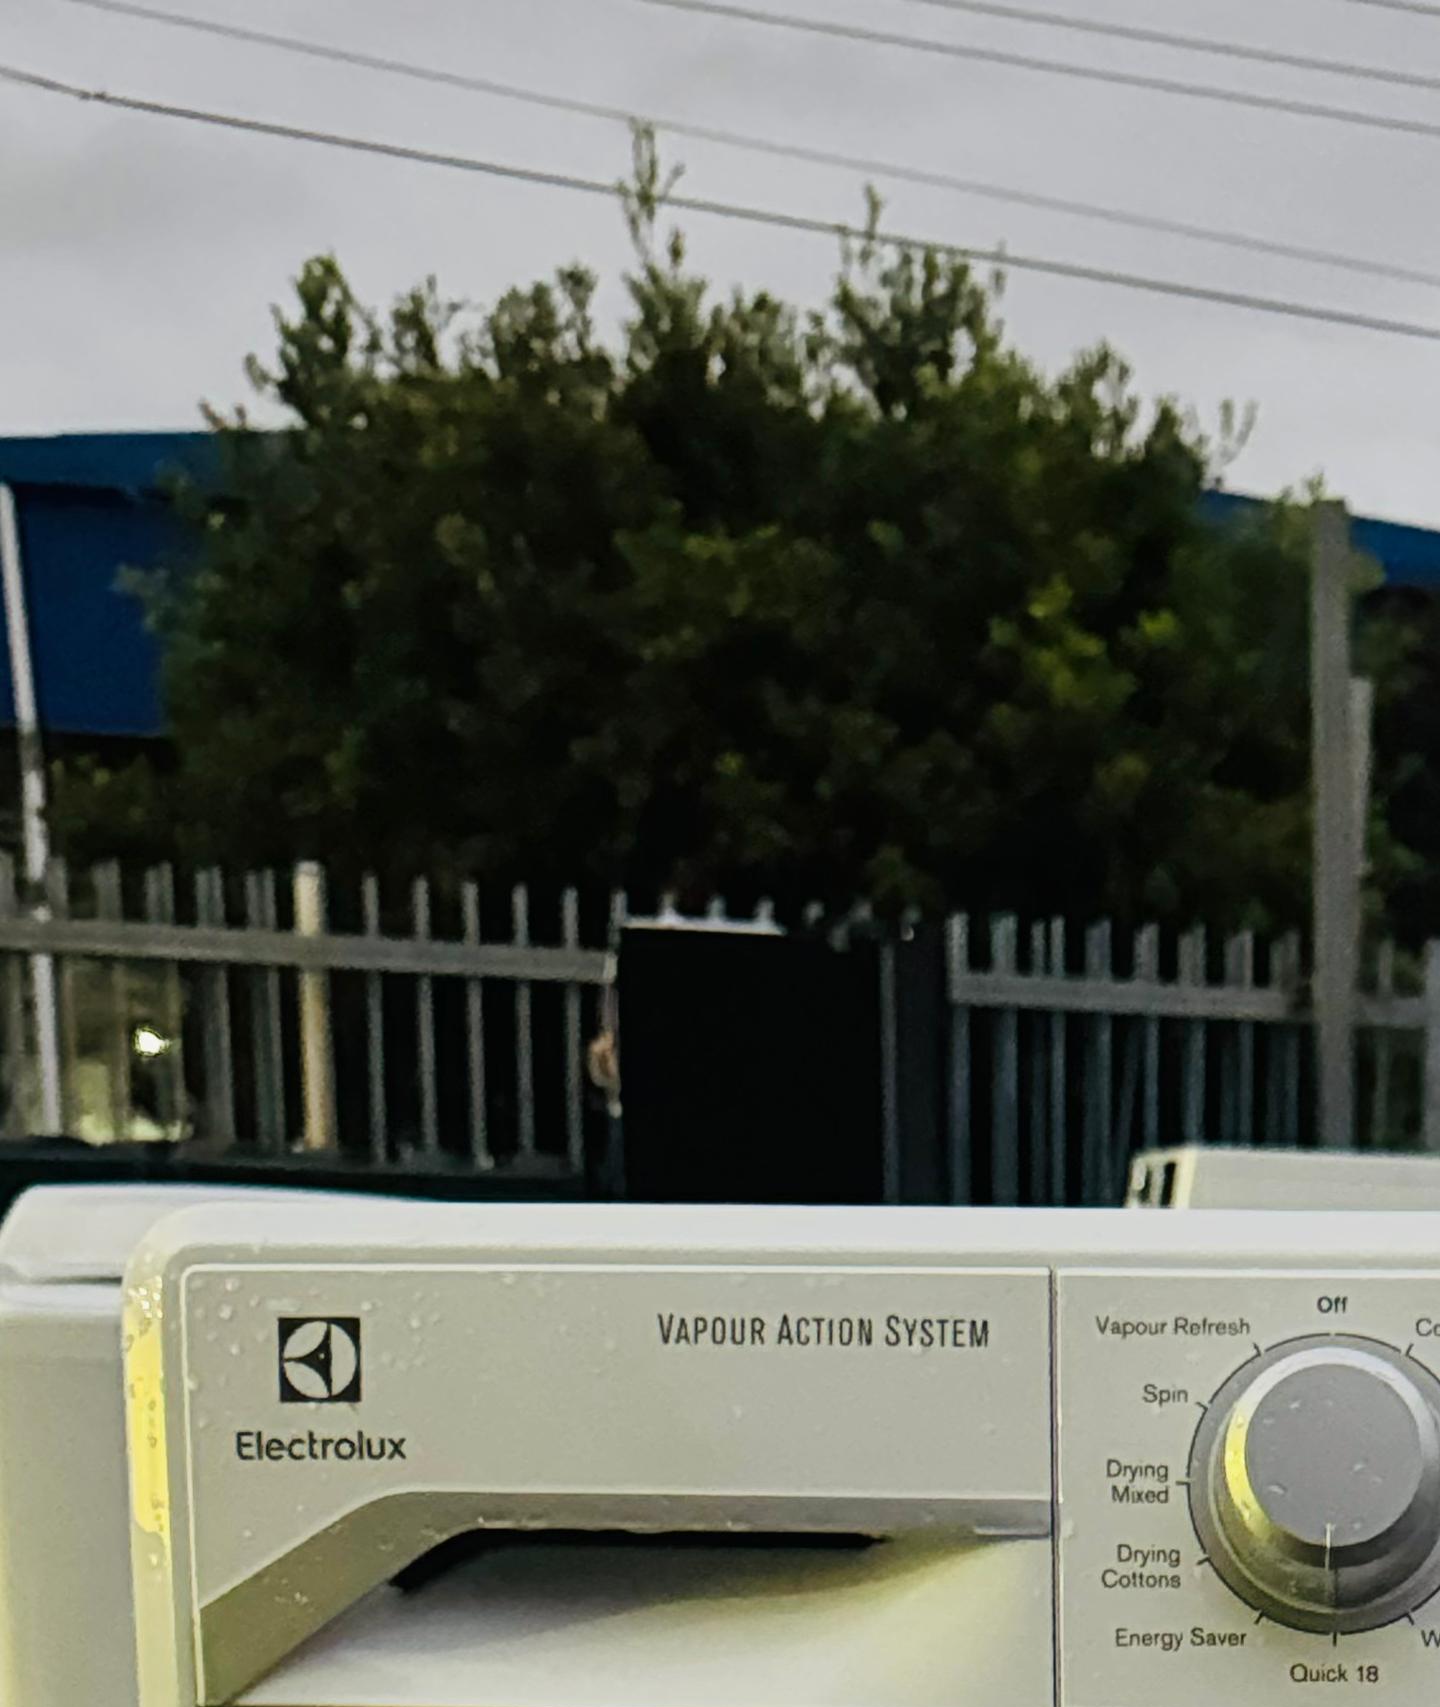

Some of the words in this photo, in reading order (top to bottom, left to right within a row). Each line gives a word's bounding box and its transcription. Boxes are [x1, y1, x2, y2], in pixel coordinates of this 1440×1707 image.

[1317, 1297, 1348, 1314] Off
[1096, 1317, 1167, 1339] Vapour
[1173, 1318, 1251, 1336] Refresh
[1143, 1384, 1189, 1408] Spin
[235, 1430, 407, 1462] Electrolux
[1106, 1459, 1169, 1483] Drying
[1111, 1485, 1169, 1504] Mixed
[1116, 1545, 1181, 1569] Drying
[1102, 1570, 1181, 1589] Cottons
[1115, 1629, 1184, 1652] Energy
[1190, 1629, 1247, 1648] Saver
[1290, 1663, 1349, 1684] Quick
[1357, 1665, 1379, 1683] 18
